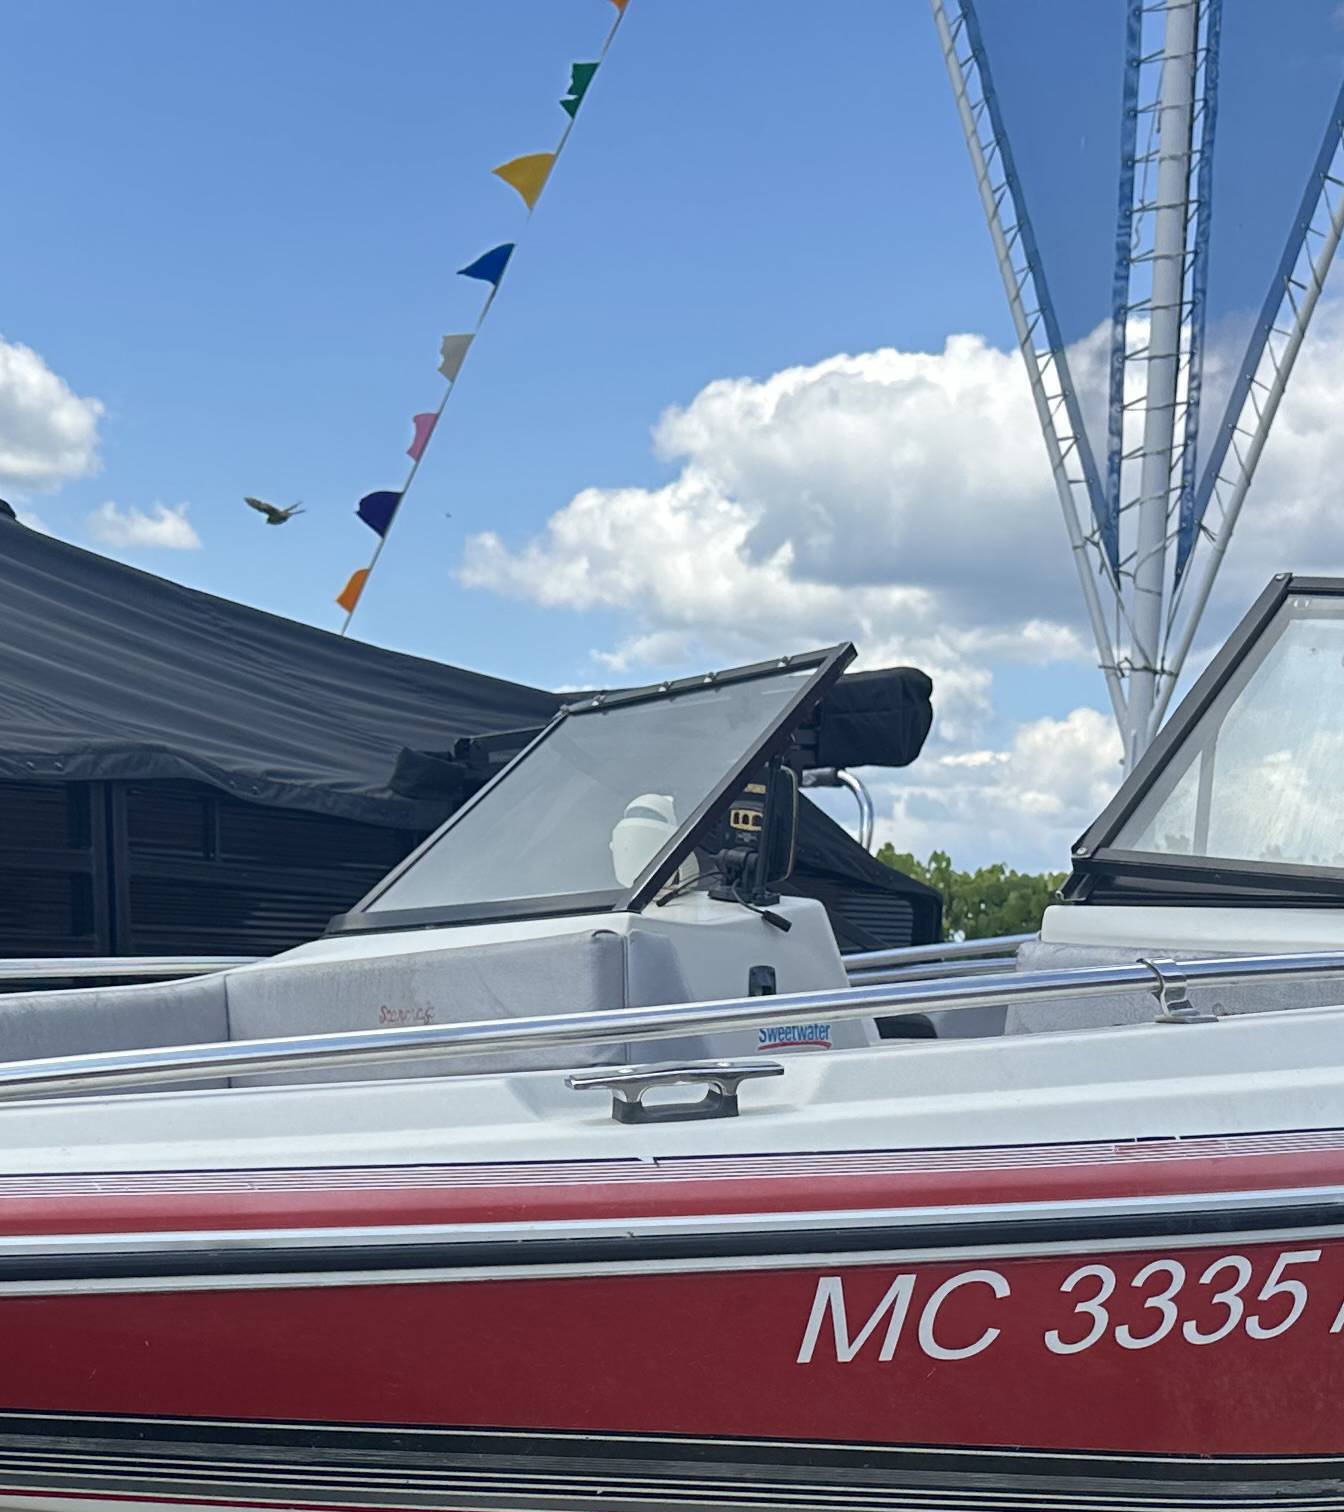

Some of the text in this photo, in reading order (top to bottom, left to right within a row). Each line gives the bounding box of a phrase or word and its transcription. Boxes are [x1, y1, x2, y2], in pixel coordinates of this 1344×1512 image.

[758, 1023, 832, 1044] Sweetwater
[796, 1269, 1011, 1364] MC
[1044, 1249, 1322, 1355] 3335
